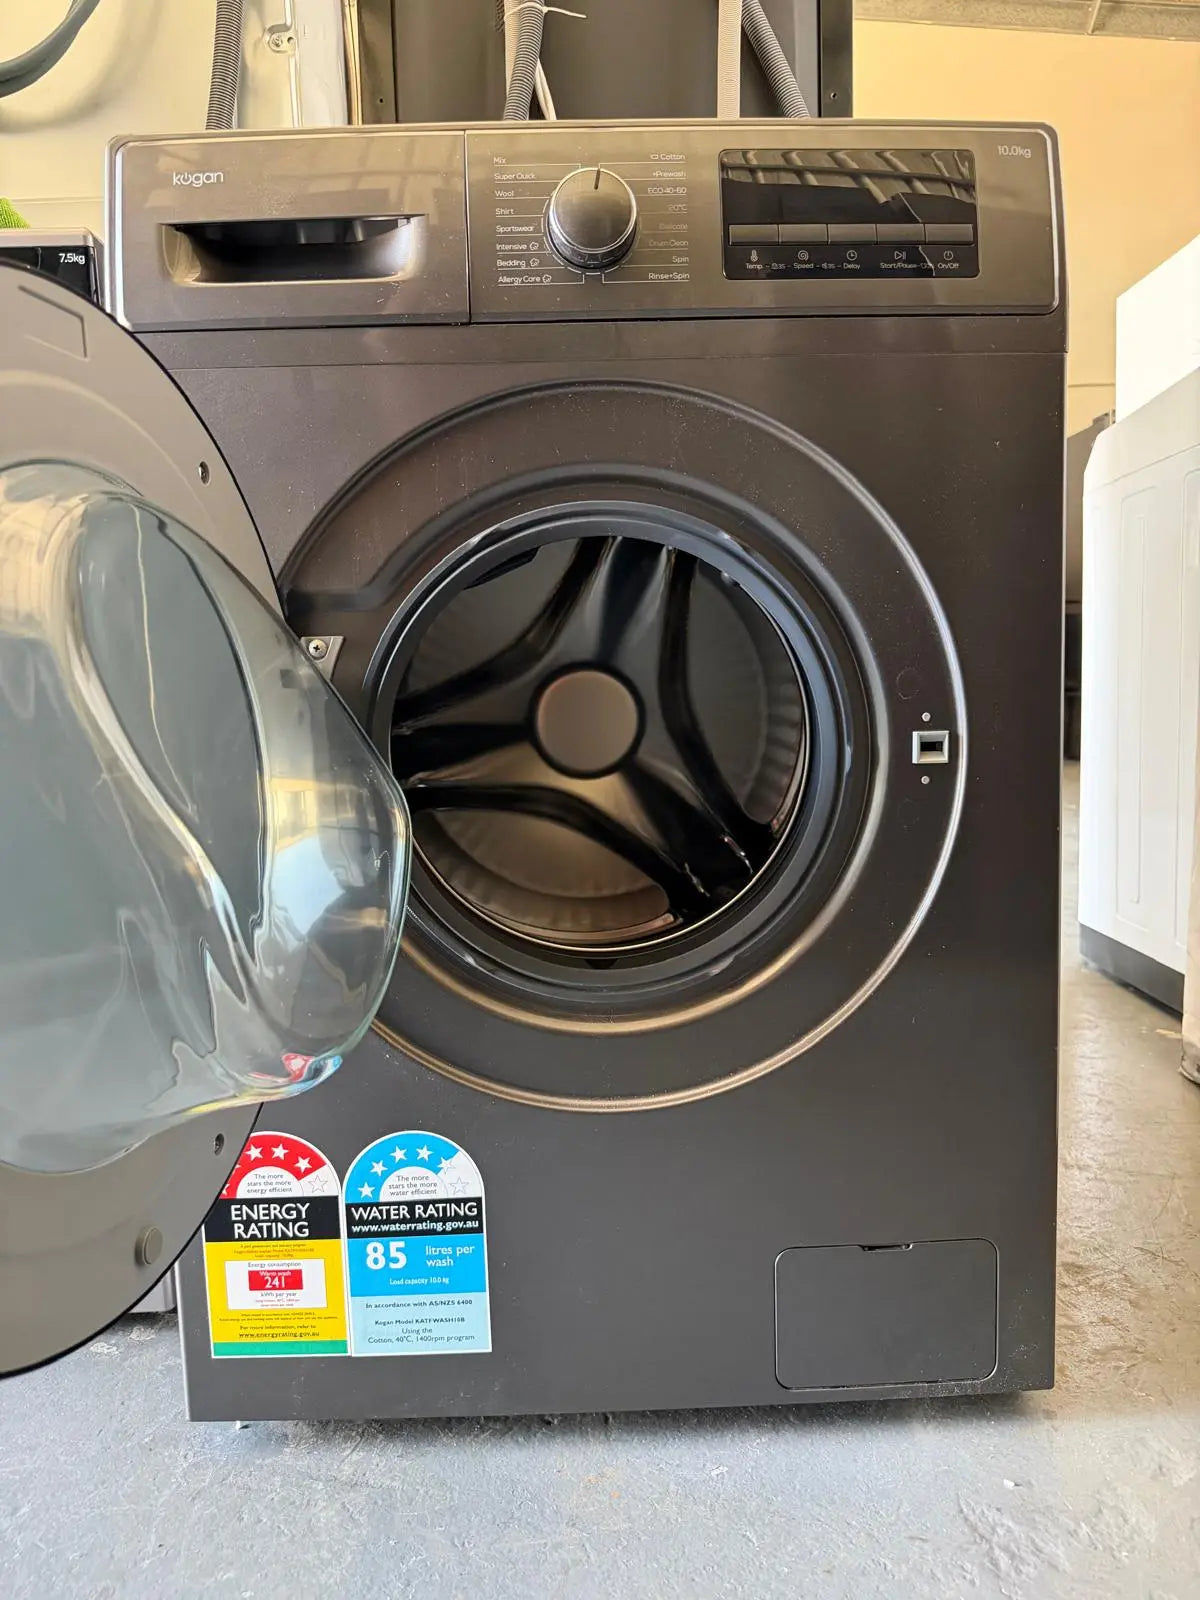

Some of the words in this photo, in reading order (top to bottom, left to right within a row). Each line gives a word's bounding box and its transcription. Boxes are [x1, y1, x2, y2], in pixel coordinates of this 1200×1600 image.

[997, 144, 1032, 159] 10.0kg
[660, 153, 686, 161] Cotton
[172, 171, 224, 188] kogan
[494, 173, 515, 181] Super
[516, 172, 536, 180] Quick
[496, 225, 534, 234] Sportswear
[58, 252, 86, 265] 7.5kg
[672, 255, 689, 263] Spin
[497, 259, 526, 269] Bedding
[793, 262, 814, 270] Speed
[843, 262, 861, 270] Delay
[498, 276, 522, 285] Allergy
[523, 275, 541, 283] Care
[648, 272, 690, 281] Rinse+Spin
[230, 1203, 310, 1220] ENERGY
[351, 1205, 410, 1221] WATER
[415, 1202, 478, 1218] RATING
[233, 1222, 309, 1239] RATING
[351, 1220, 479, 1233] www.waterrating.gov.au
[366, 1240, 408, 1270] 85
[425, 1245, 453, 1255] litres
[456, 1246, 475, 1257] per
[247, 1261, 266, 1269] Energy
[425, 1256, 454, 1267] wash
[264, 1276, 286, 1288] 241
[404, 1278, 428, 1286] capacity
[415, 1334, 445, 1344] 1400rpm
